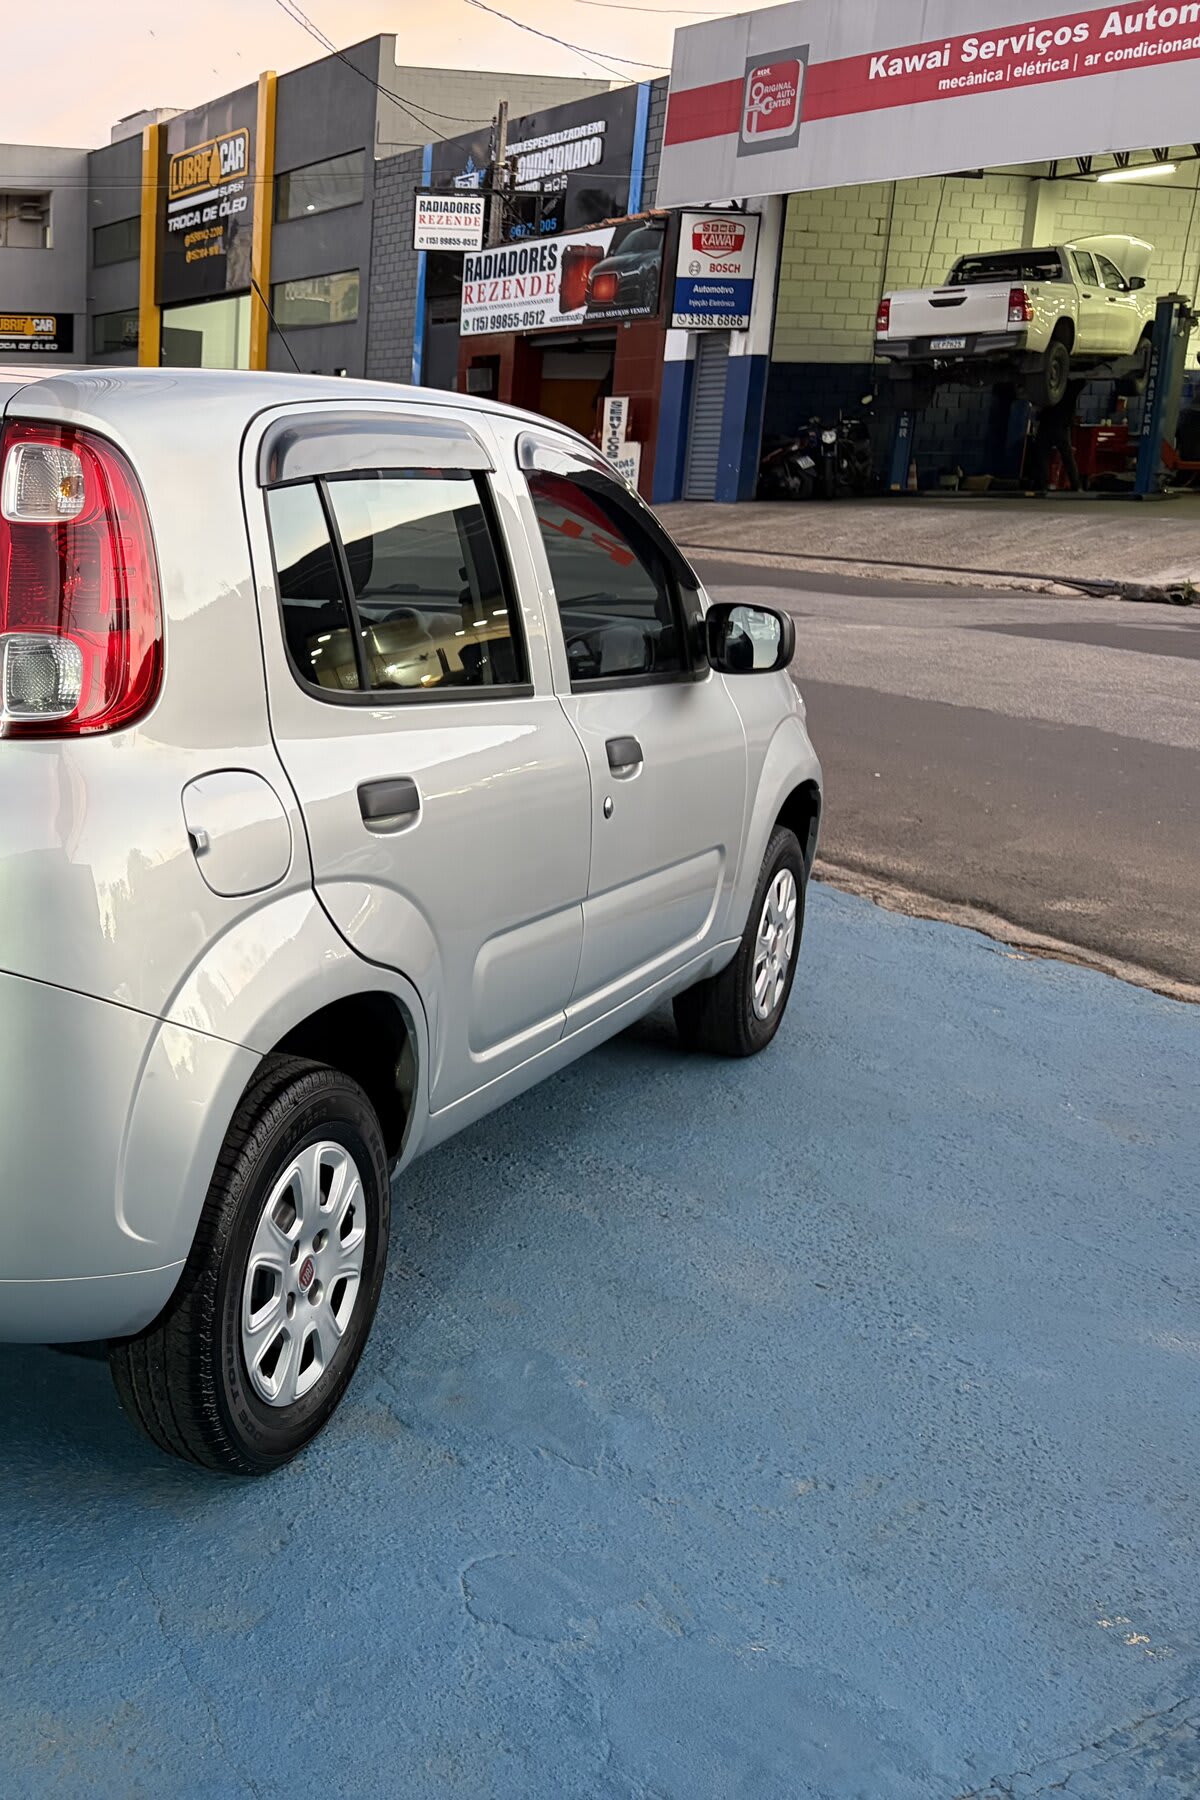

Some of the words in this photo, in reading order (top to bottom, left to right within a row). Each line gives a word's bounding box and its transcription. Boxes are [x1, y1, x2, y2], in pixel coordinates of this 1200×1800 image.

[869, 43, 951, 80] Kawai
[960, 22, 1090, 63] Serviços
[938, 69, 1004, 91] mecânica
[1013, 57, 1070, 79] elétrica
[1084, 53, 1102, 67] ar
[776, 88, 796, 99] AUTO
[515, 136, 602, 183] ONDICIONADO
[168, 211, 202, 232] TROCA
[202, 205, 218, 223] DE
[219, 196, 248, 218] ÓLEO
[419, 200, 482, 215] RADIADORES
[418, 214, 481, 227] REZENDE
[700, 234, 736, 247] KAWAI
[464, 243, 558, 283] RADIADORES
[709, 263, 741, 274] BOSCH
[463, 273, 556, 305] REZENDE
[693, 284, 735, 295] Automotivo
[472, 316, 488, 331] (15)
[490, 310, 545, 330] 99855-0512
[687, 313, 743, 326] 3388.6866
[18, 342, 31, 350] DE
